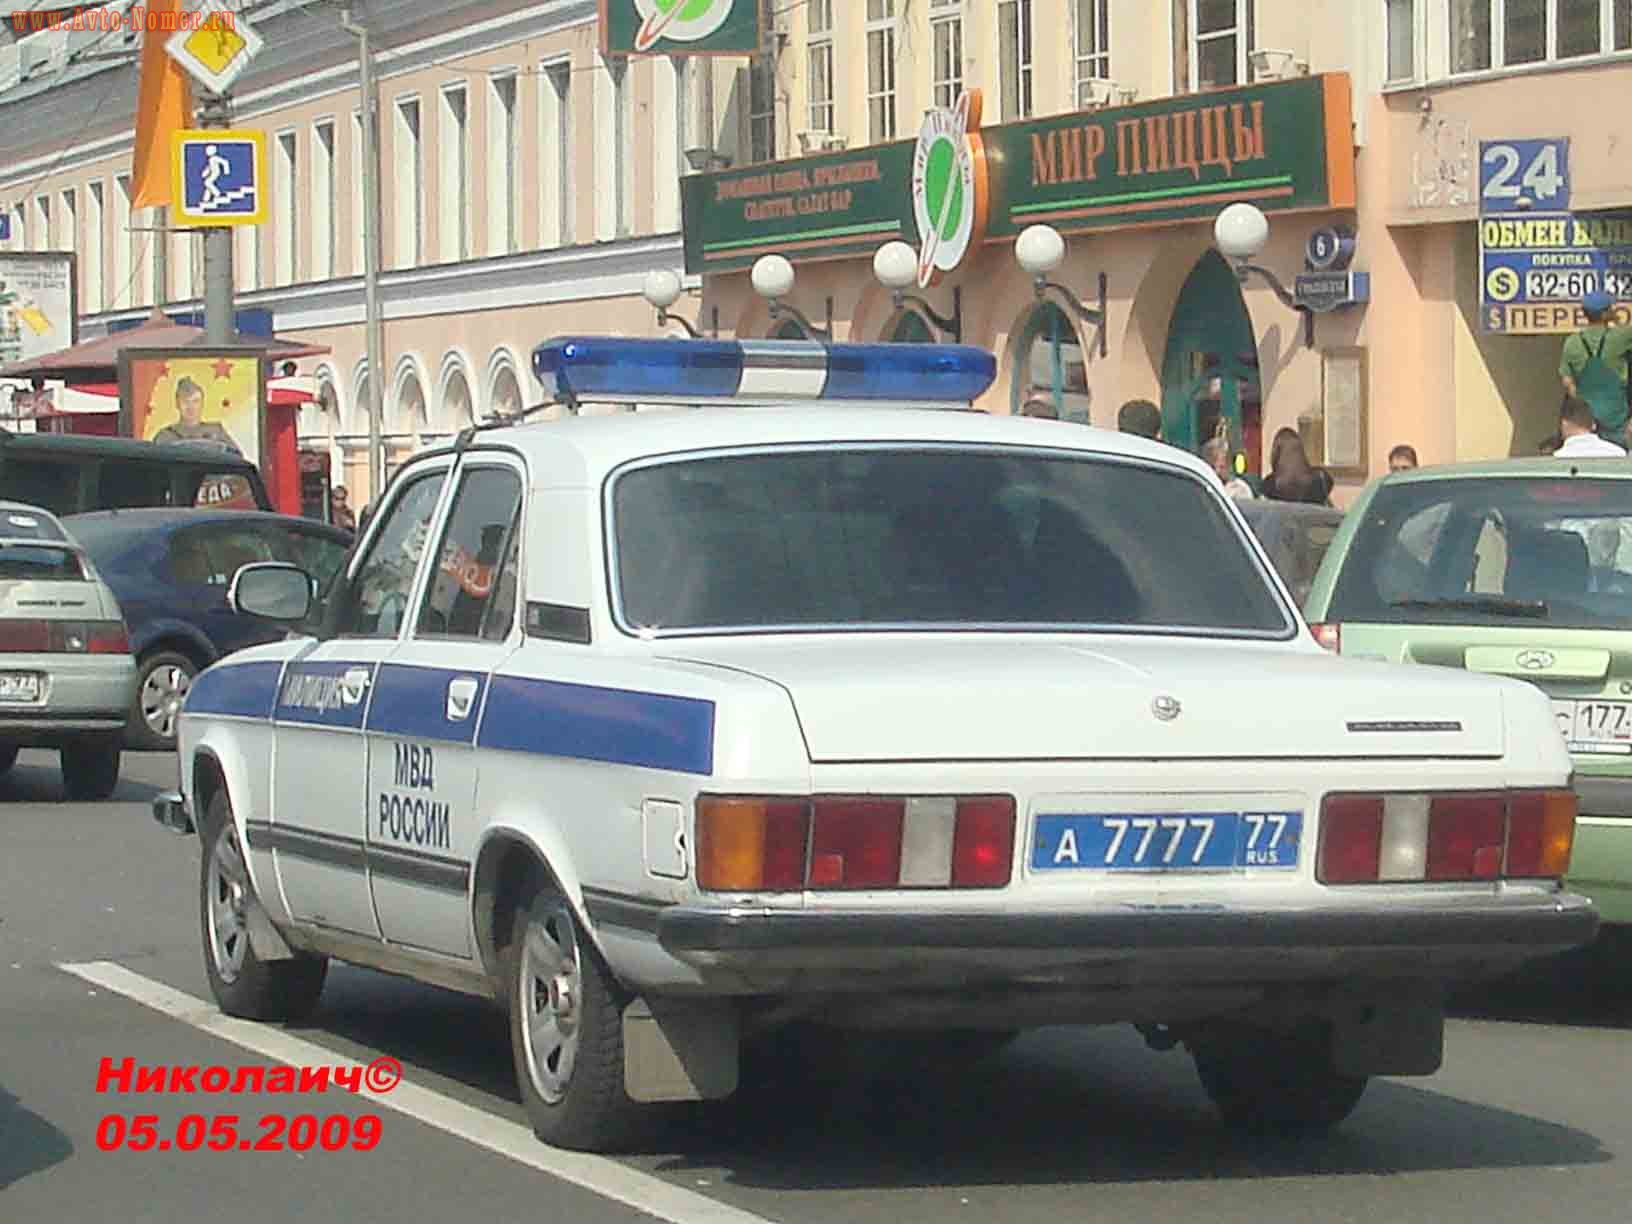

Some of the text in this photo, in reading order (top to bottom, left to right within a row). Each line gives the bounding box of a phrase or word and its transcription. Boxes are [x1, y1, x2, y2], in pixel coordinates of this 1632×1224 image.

[1031, 125, 1105, 187] МИР
[1115, 100, 1265, 181] ПИЦЦЫ
[1483, 144, 1565, 199] 24
[1484, 219, 1566, 248] ОБМЕН
[1532, 253, 1592, 266] ПОКУПКА
[1580, 703, 1627, 729] 177
[394, 742, 433, 789] МВД
[379, 793, 450, 848] РОССИИ
[1053, 814, 1288, 864] А 7777 77
[1246, 850, 1279, 865] RUS
